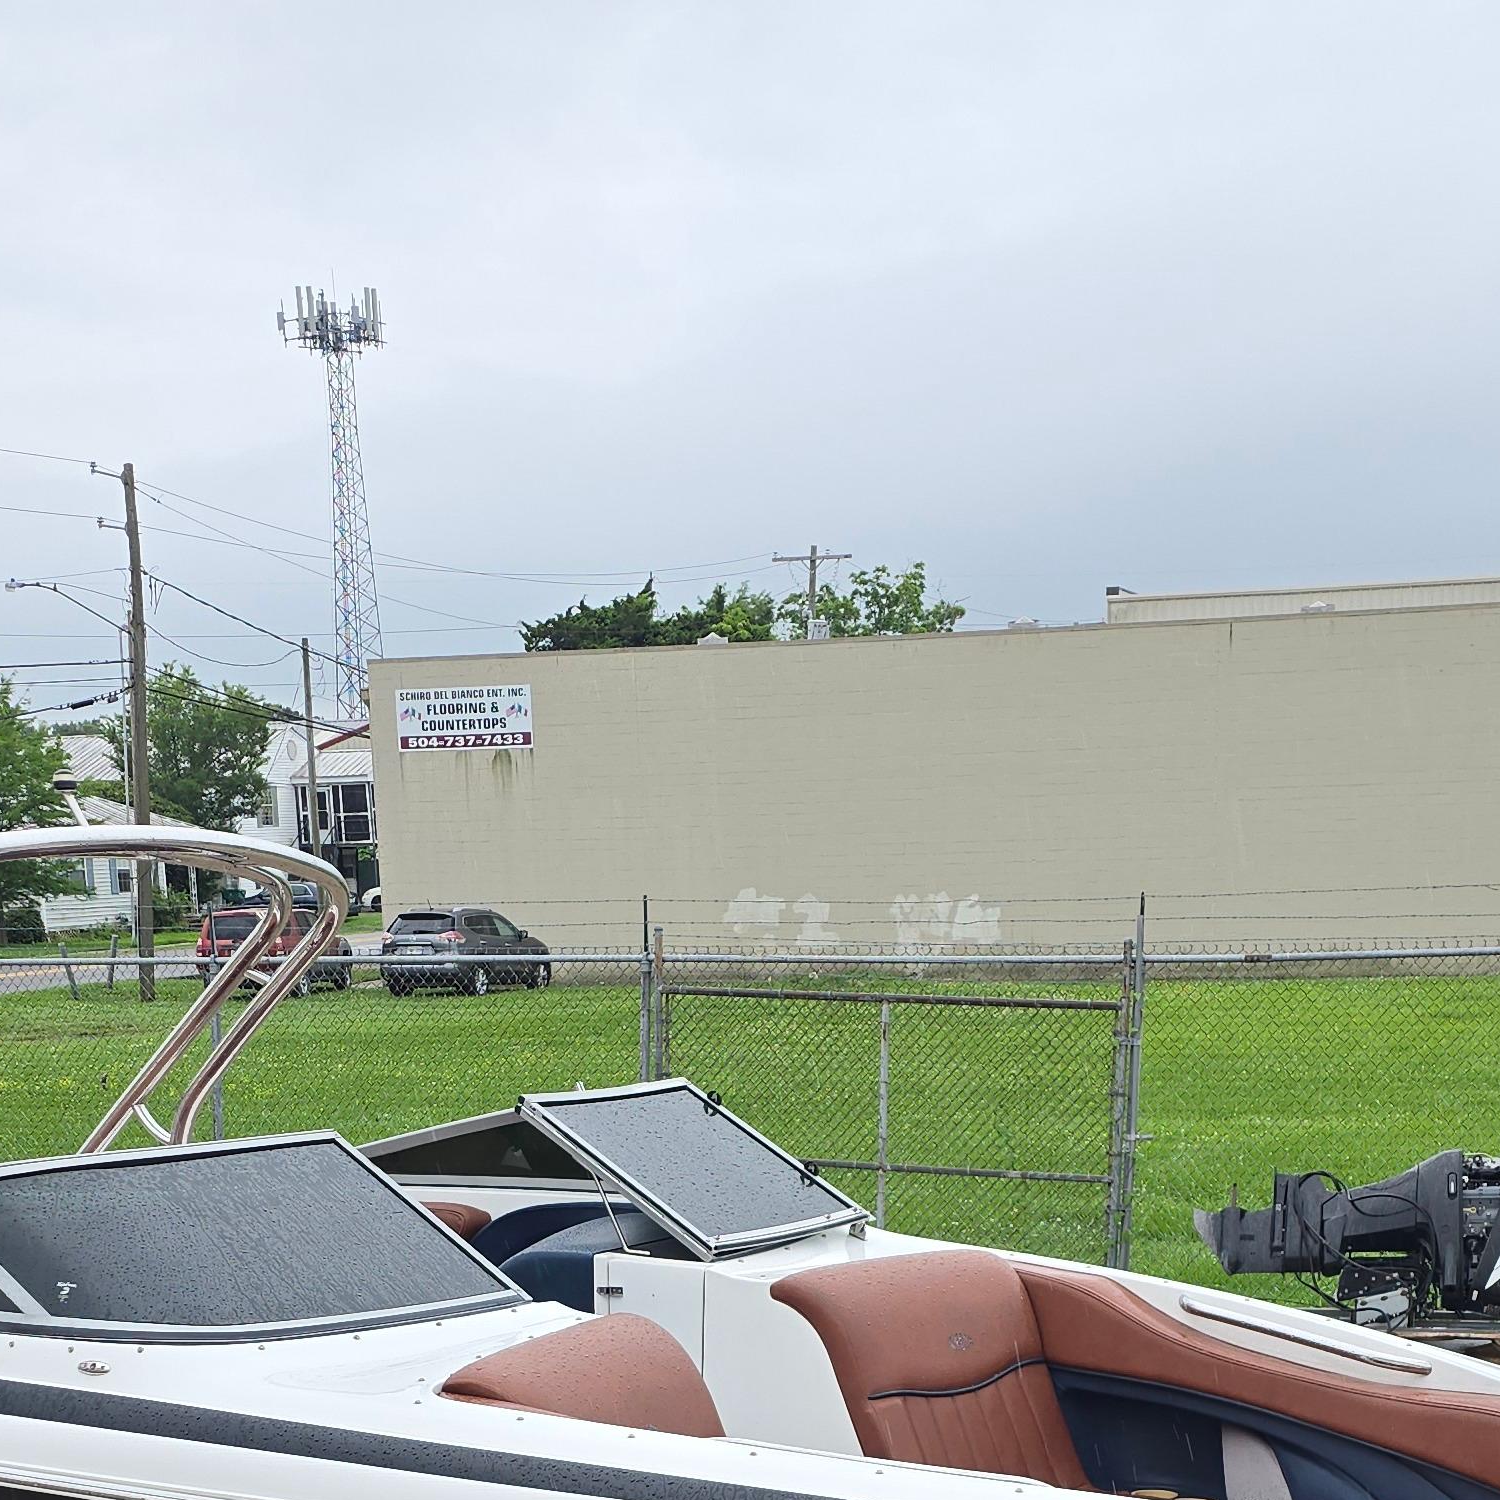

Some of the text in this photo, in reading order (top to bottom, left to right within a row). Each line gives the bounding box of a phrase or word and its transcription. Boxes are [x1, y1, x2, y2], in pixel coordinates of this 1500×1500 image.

[399, 687, 527, 701] SCHIRO DEL BIANCO ENT. INC.
[426, 701, 500, 716] FLOORING &
[421, 717, 507, 731] COUNTERTOPS
[408, 733, 524, 748] 504-737-7433
